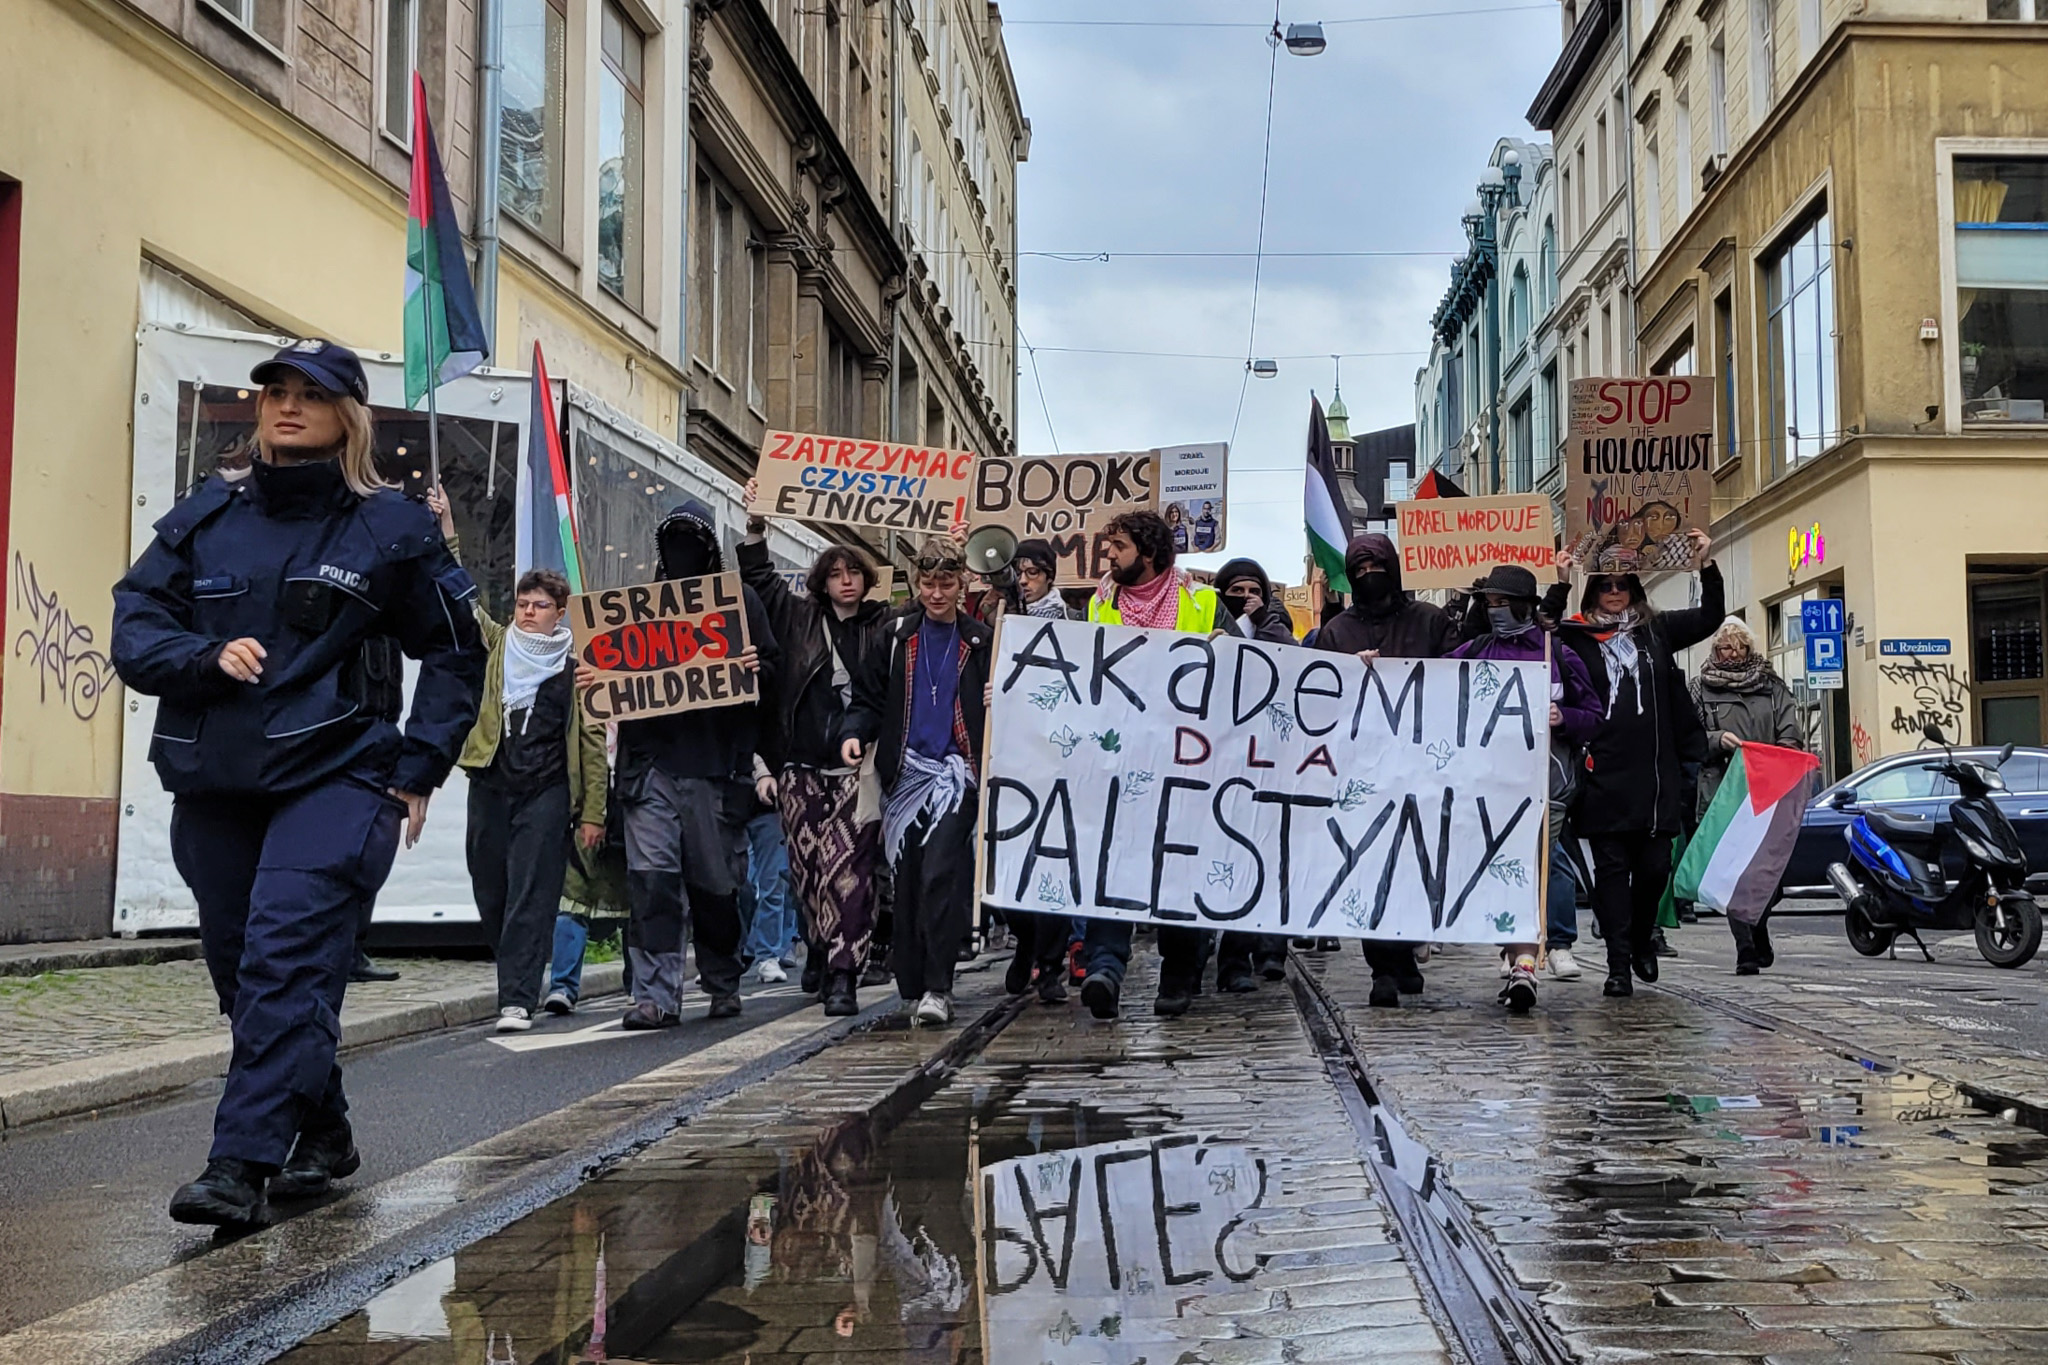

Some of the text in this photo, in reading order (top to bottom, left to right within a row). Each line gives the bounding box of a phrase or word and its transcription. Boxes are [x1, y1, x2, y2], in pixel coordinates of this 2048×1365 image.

[1597, 380, 1691, 424] STOP
[1630, 426, 1655, 438] THE
[769, 434, 976, 481] ZATRZYMAĆ
[1583, 433, 1713, 474] HOLOCAUST
[801, 466, 927, 498] CZYSTKI
[1174, 468, 1210, 476] MORDUJE
[1609, 472, 1693, 497] IN GAZA
[1165, 483, 1218, 493] DZIENNIKARZY
[775, 485, 966, 531] ETNICZNE!
[1026, 508, 1092, 534] NOT
[1401, 508, 1454, 536] IZRAEL
[1587, 497, 1631, 524] NOW
[1404, 545, 1463, 572] EUROPA
[582, 575, 738, 629] ISRAEL
[590, 612, 730, 670] BOMBS
[1814, 638, 1835, 667] P
[1883, 640, 1948, 653] ul. Rzeźnicza
[583, 664, 756, 720] CHILDREN
[1174, 726, 1338, 777] DLA
[983, 776, 1532, 931] PALESTYNY
